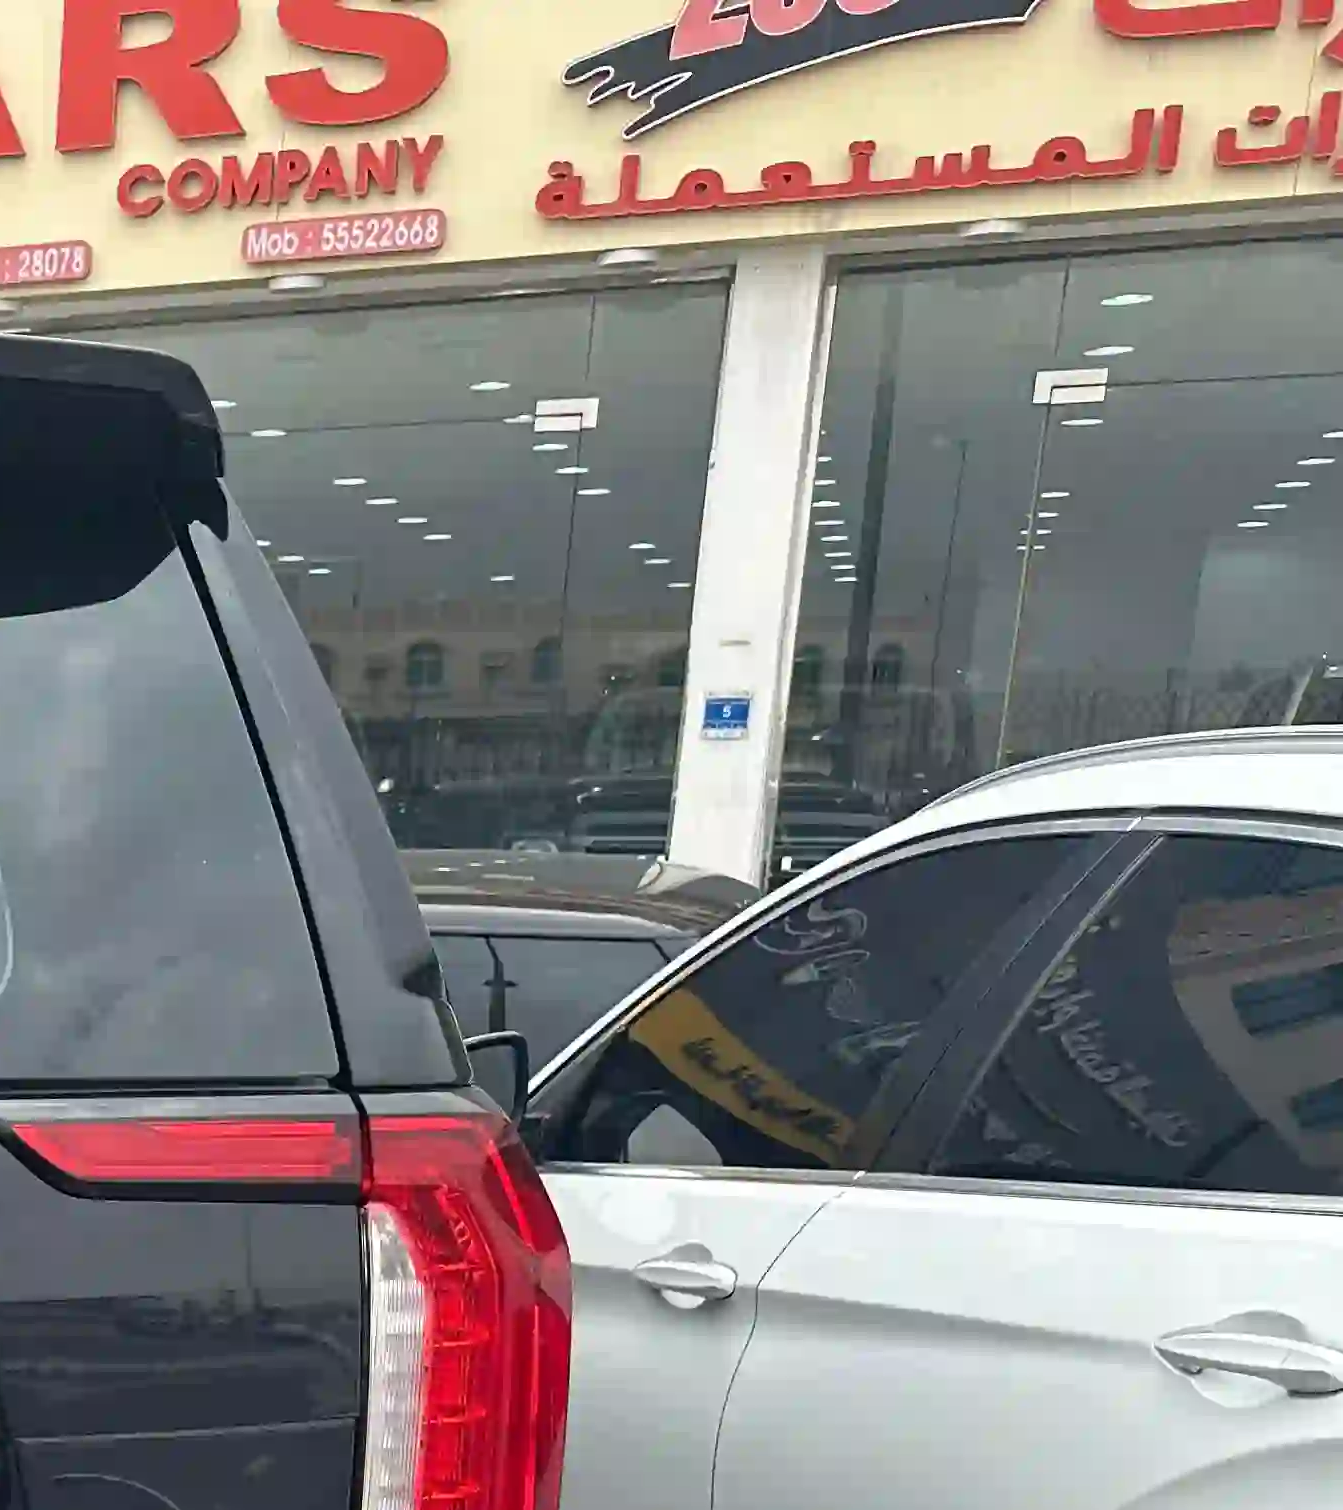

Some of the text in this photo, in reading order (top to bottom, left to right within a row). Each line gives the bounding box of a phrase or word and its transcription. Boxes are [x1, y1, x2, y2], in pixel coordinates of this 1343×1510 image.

[117, 135, 444, 217] COMPANY
[534, 104, 1184, 221] المستعملة
[18, 245, 86, 278] 28078
[247, 226, 299, 258] Mob
[321, 214, 439, 252] 55522668
